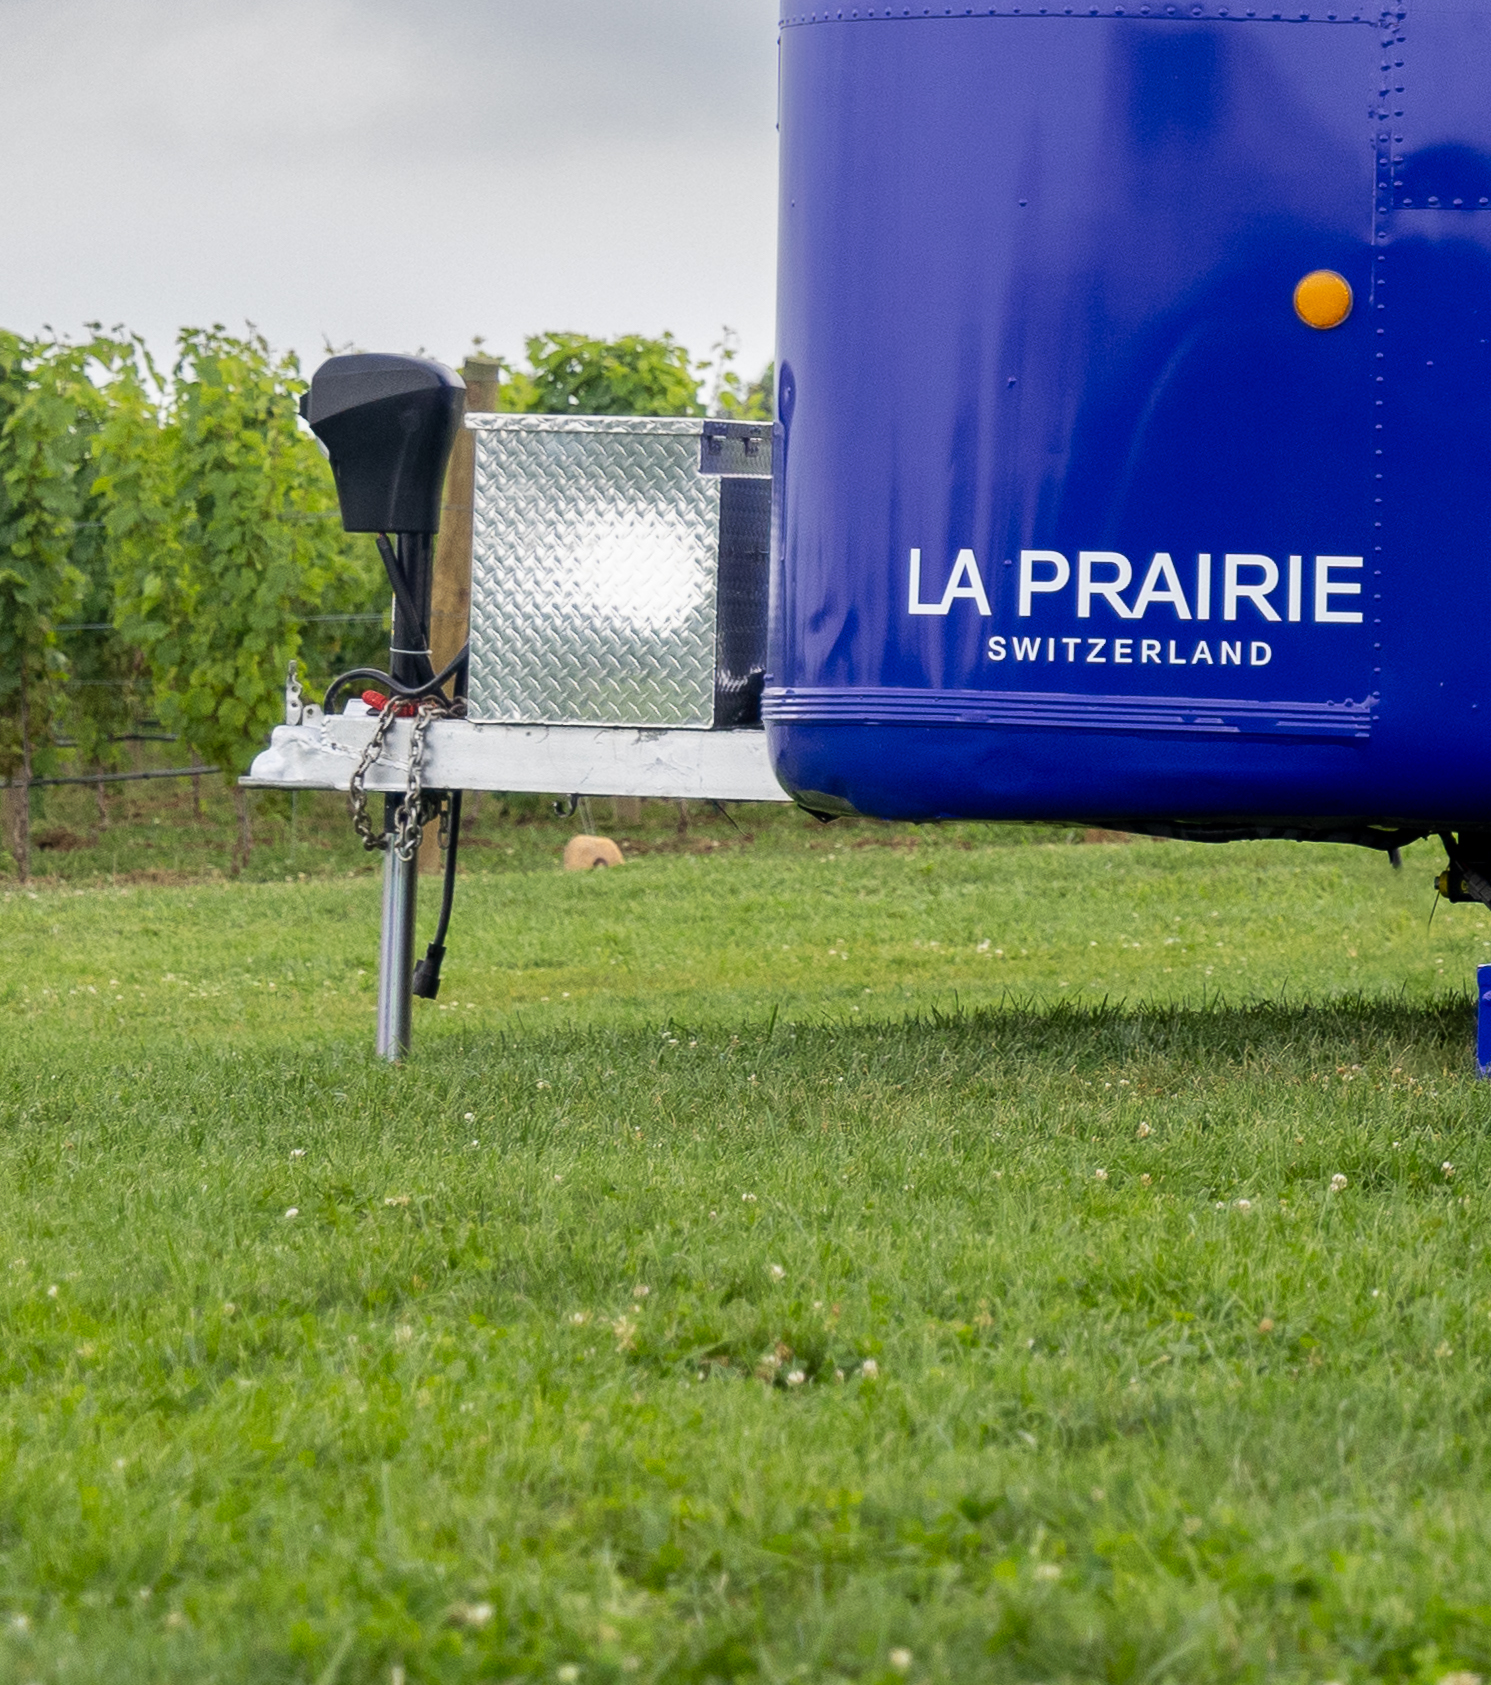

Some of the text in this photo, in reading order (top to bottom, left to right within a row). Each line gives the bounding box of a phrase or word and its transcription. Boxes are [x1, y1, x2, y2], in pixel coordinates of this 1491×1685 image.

[908, 548, 1364, 623] LA PRAIRIE
[987, 636, 1273, 666] SWITZERLAND
